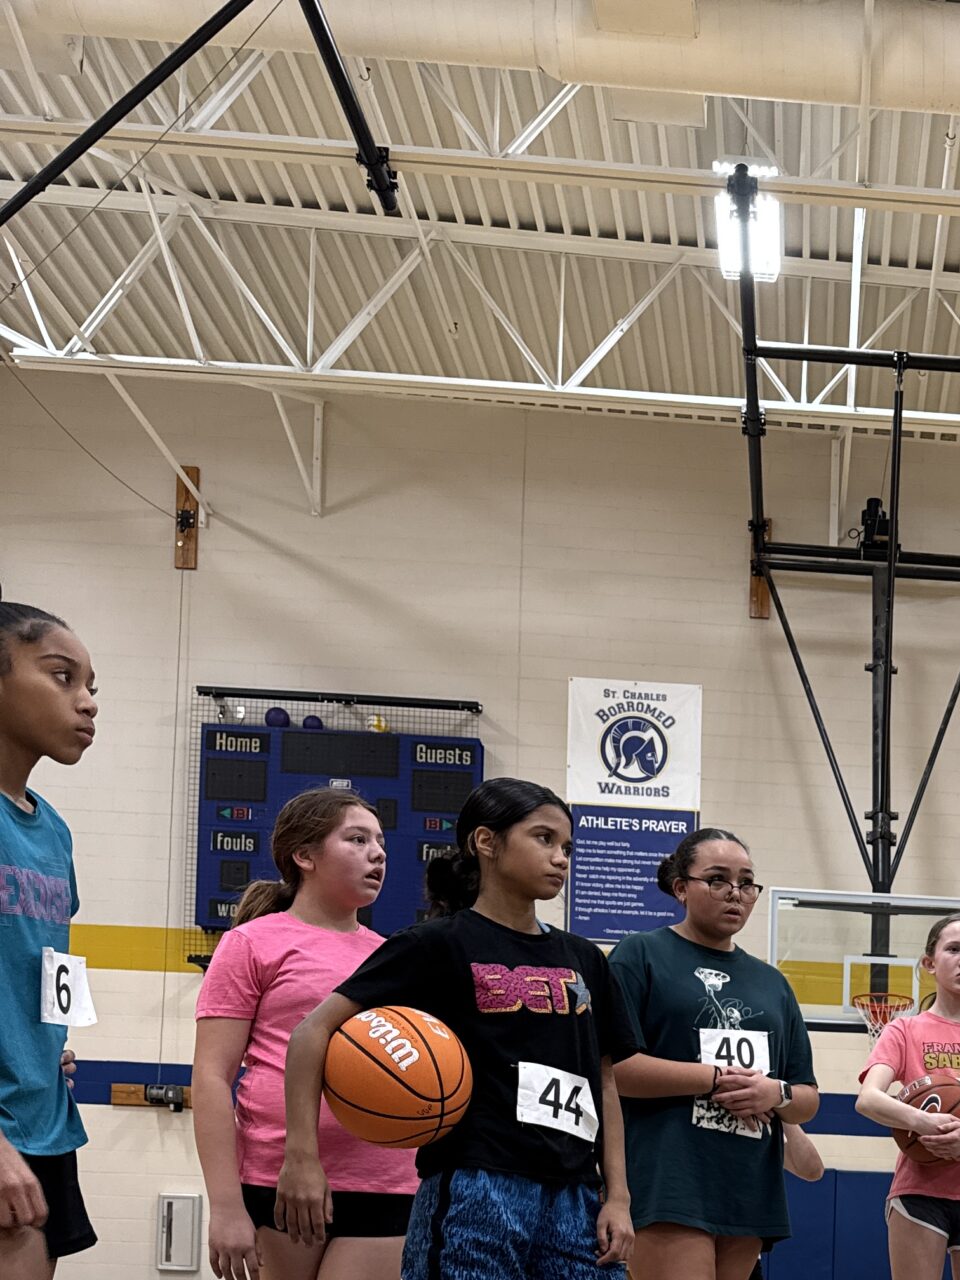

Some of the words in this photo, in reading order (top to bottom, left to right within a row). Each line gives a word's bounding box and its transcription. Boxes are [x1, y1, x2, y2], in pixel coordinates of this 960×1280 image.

[623, 690, 667, 702] CHARLES
[595, 701, 676, 729] BORROMEO
[216, 732, 261, 753] Home
[416, 744, 471, 765] Guests
[597, 782, 670, 798] WARRIORS
[579, 816, 639, 831] ATHLETE'S
[642, 819, 688, 833] PRAYER
[470, 962, 576, 1014] BET
[715, 1037, 755, 1069] 40
[538, 1077, 584, 1126] 44
